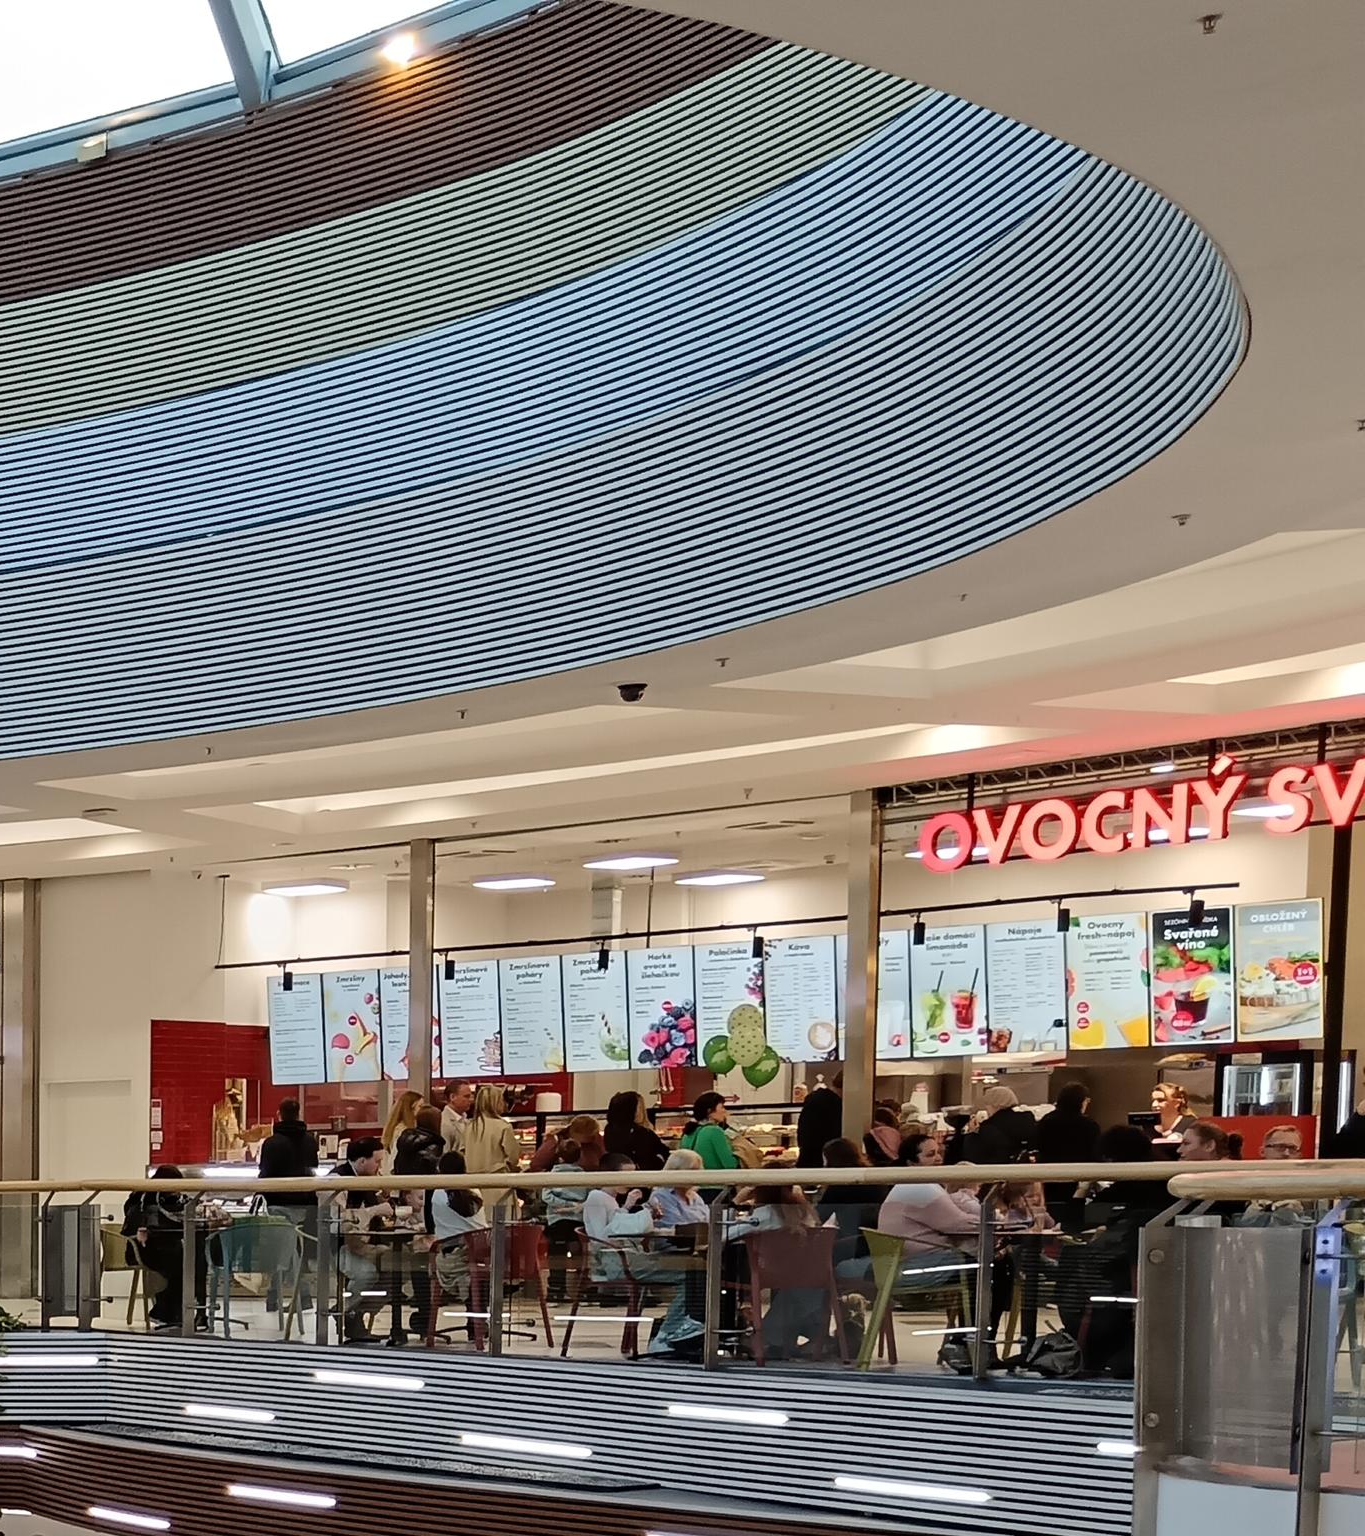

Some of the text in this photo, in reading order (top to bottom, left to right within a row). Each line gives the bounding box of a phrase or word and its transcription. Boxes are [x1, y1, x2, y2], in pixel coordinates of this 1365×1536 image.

[918, 753, 1248, 873] OVOCNÝ
[1249, 909, 1309, 922] OBLOŽENÝ
[1087, 919, 1125, 931] Ovocný
[925, 931, 976, 942] aše domácí
[1007, 926, 1042, 937] Nápoje
[1163, 924, 1219, 941] Svařené
[925, 941, 969, 951] limonáda
[1176, 938, 1207, 951] víno
[708, 947, 748, 957] Palačinka
[454, 965, 488, 975] mrzlinové
